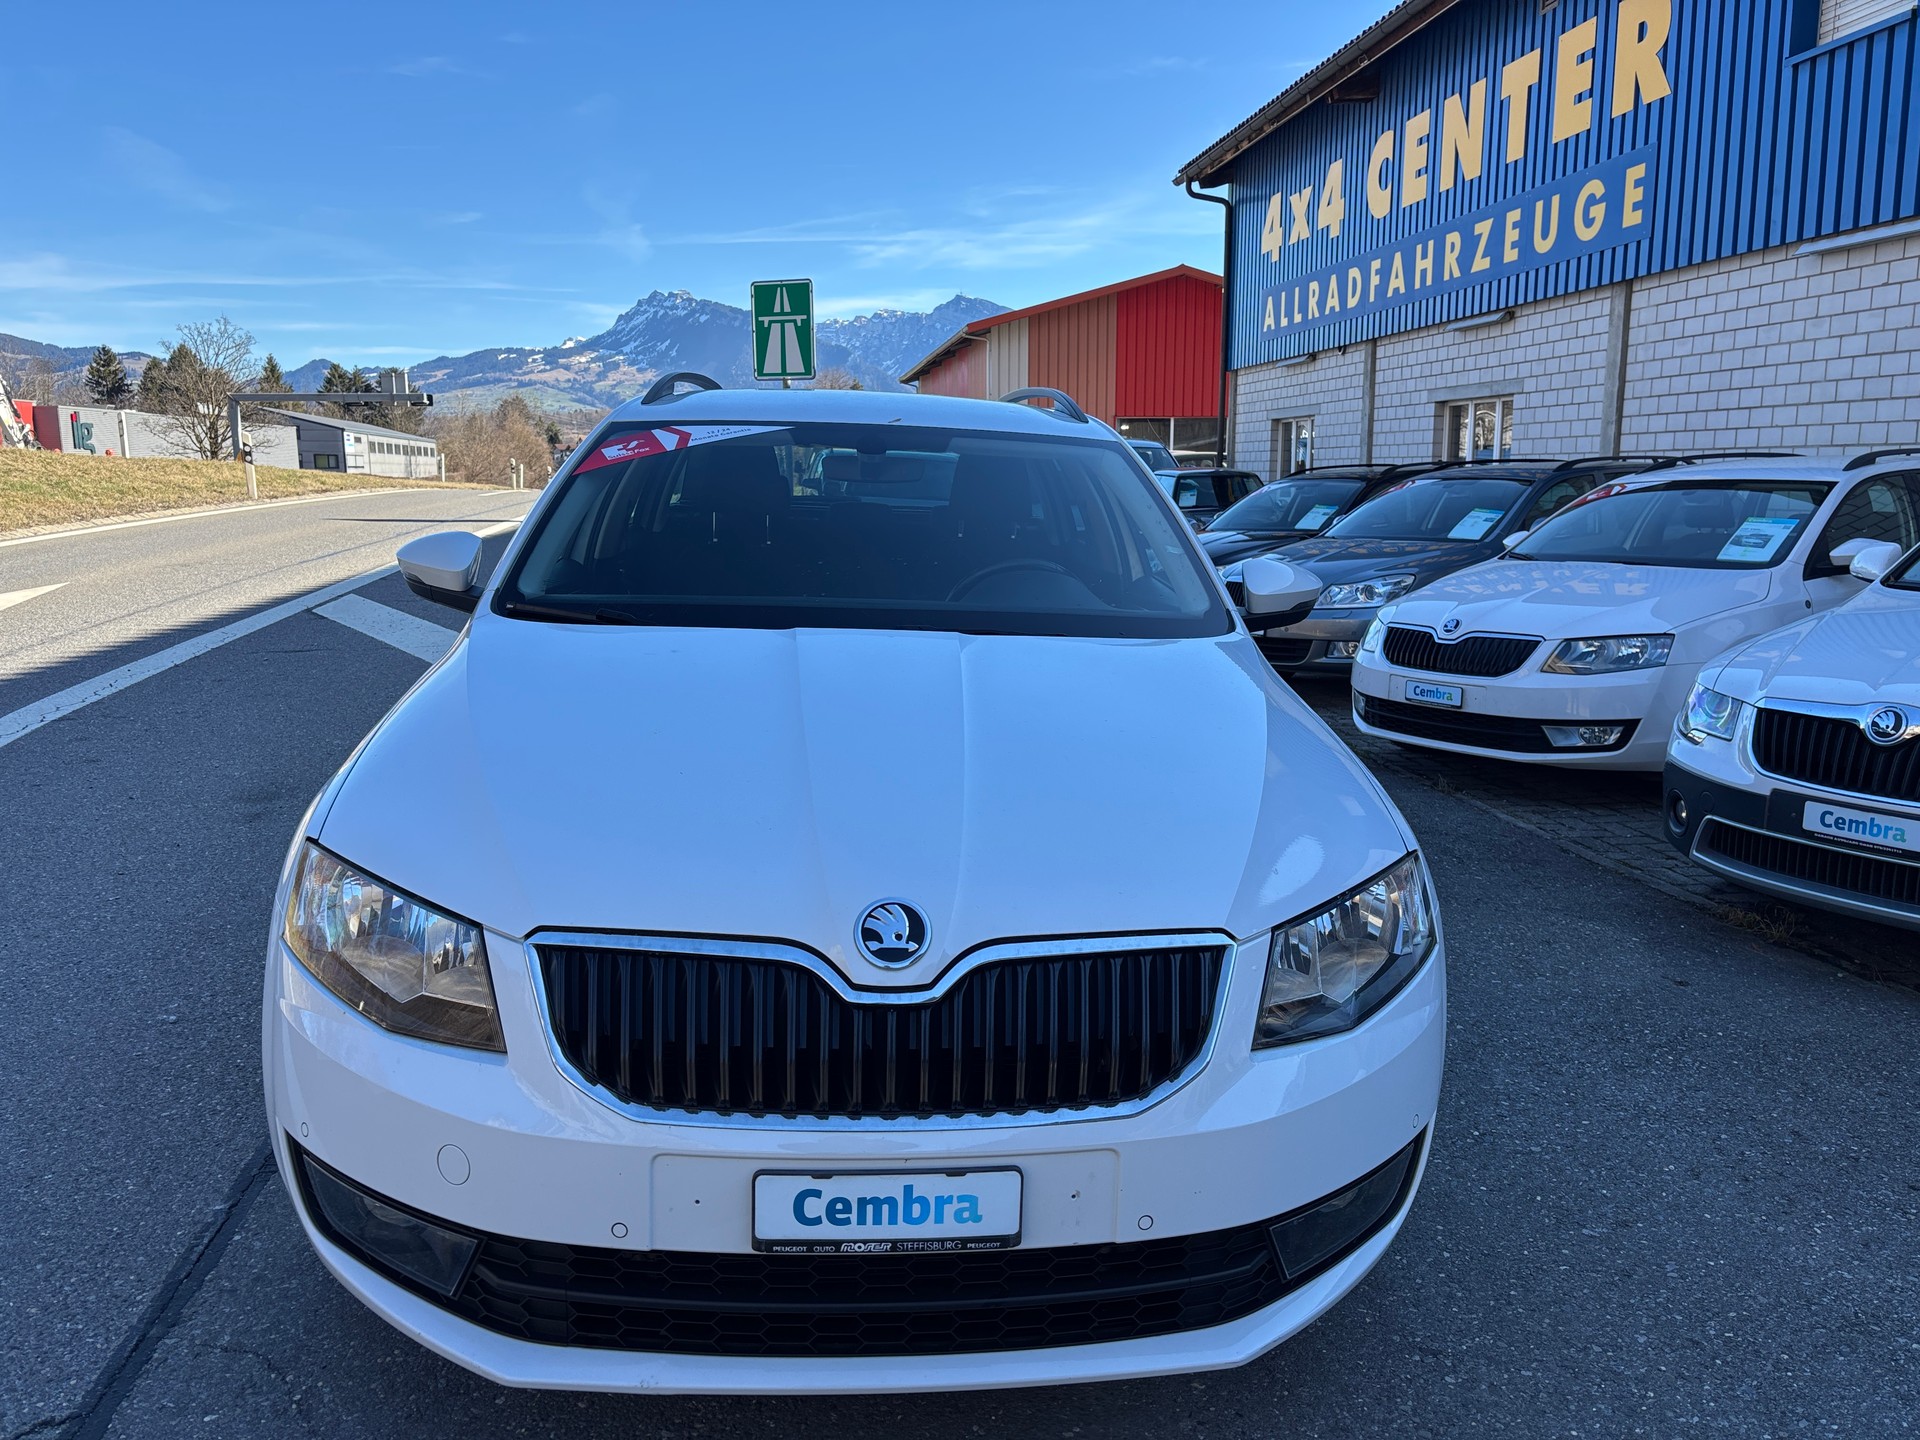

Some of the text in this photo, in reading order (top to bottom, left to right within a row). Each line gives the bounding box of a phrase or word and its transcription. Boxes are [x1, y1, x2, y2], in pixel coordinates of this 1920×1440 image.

[1366, 0, 1672, 220] CENTER
[1263, 162, 1646, 333] ALLRADFAHRZEUGE
[1414, 685, 1453, 701] Cembra
[1820, 811, 1906, 843] Cembra
[792, 1184, 983, 1227] Cembra
[896, 1240, 962, 1251] STEFFISBURG
